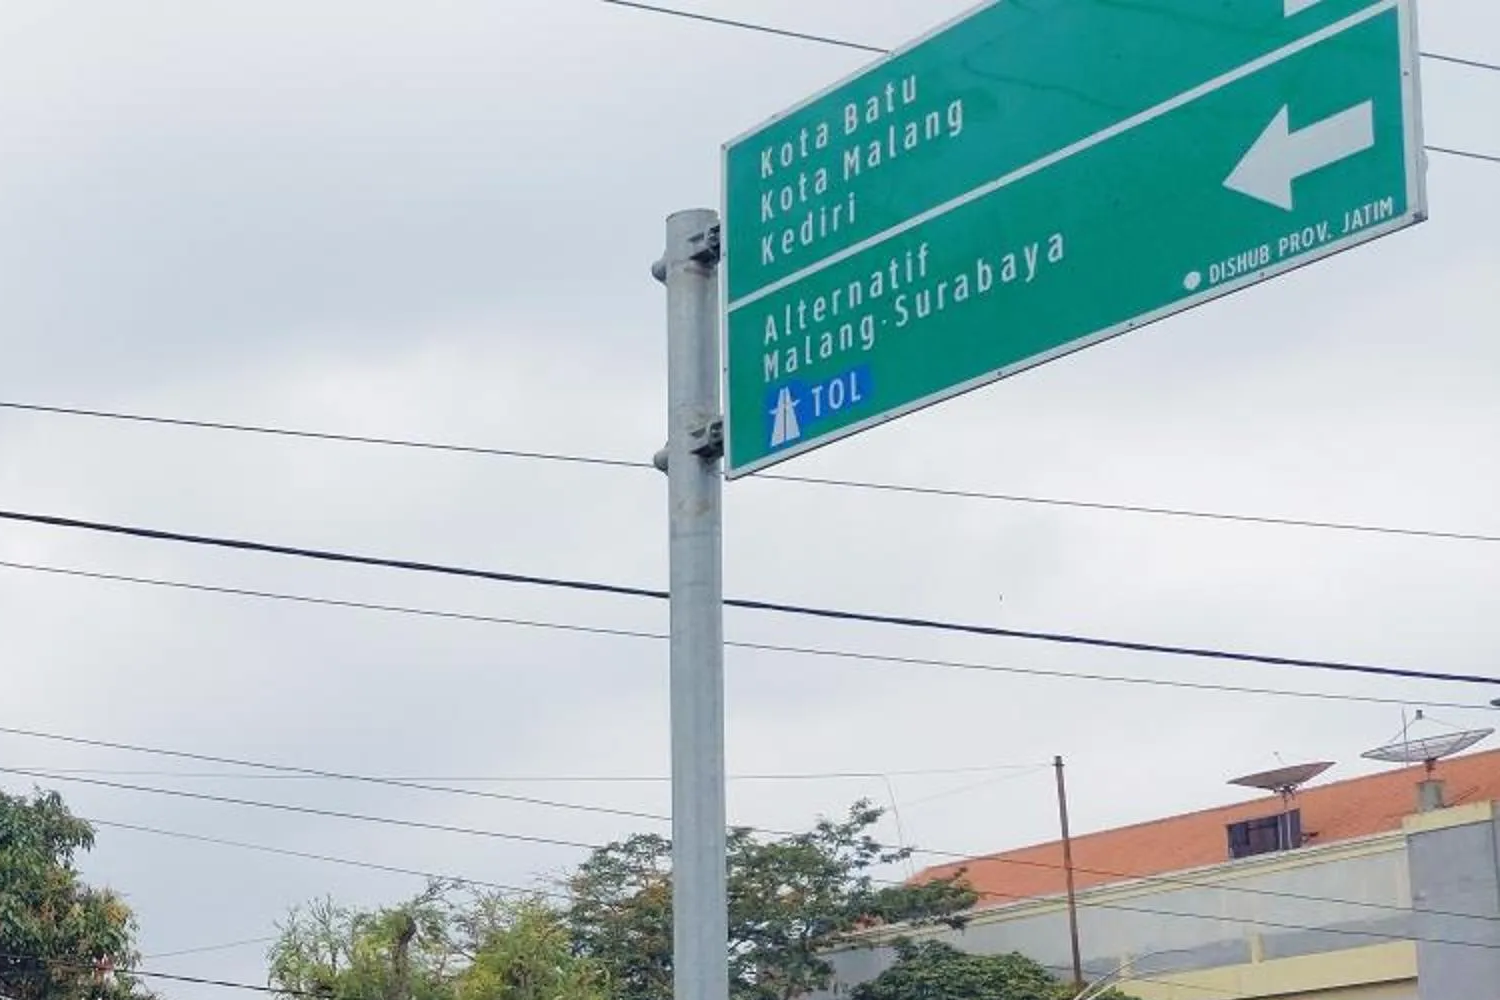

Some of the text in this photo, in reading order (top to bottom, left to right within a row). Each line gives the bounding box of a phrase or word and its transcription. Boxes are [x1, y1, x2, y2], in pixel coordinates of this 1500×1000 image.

[760, 74, 916, 179] Kota Batu
[760, 99, 963, 223] Kota Malang
[761, 191, 856, 266] Kediri
[1209, 196, 1394, 284] DISHUB PROV. JATIM
[764, 242, 930, 345] Alternatif
[811, 371, 861, 417] TOL
